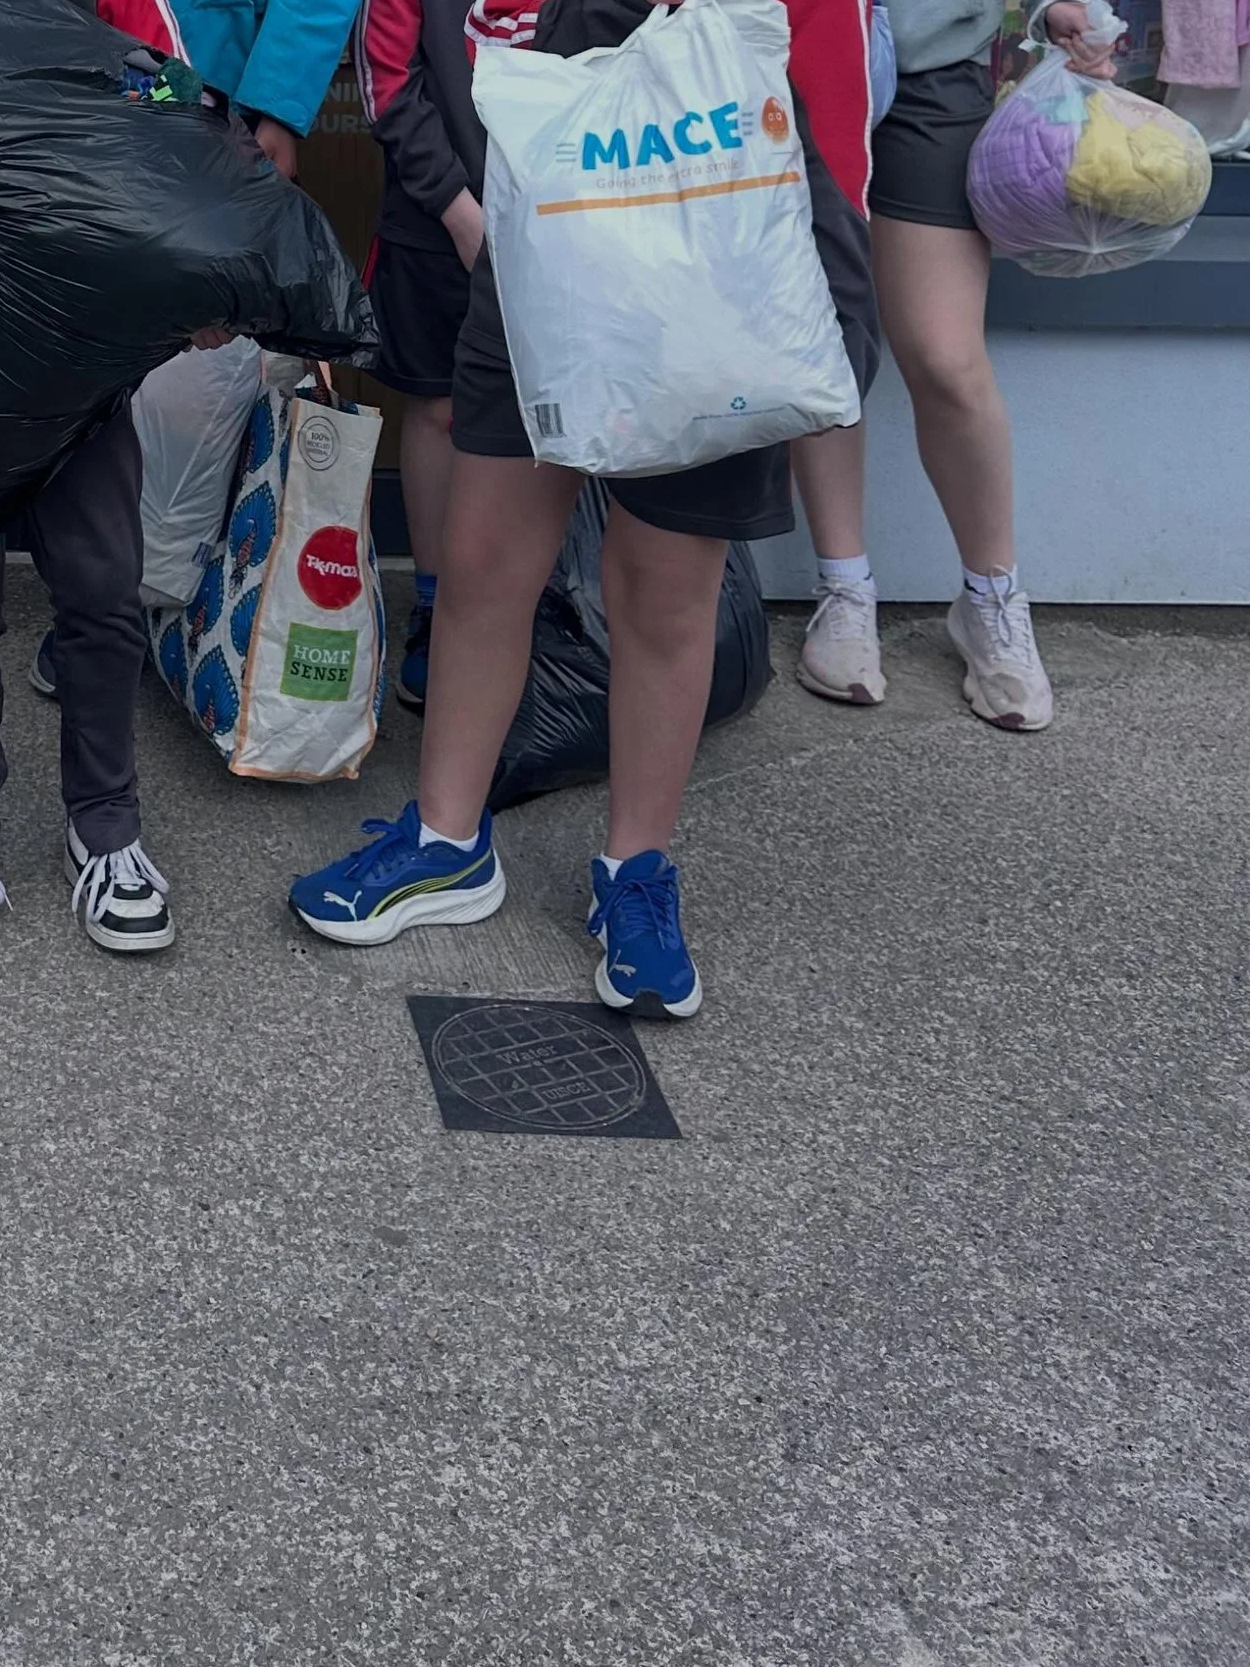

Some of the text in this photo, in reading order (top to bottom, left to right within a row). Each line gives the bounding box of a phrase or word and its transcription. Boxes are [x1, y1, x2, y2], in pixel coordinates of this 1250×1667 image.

[582, 101, 743, 171] MACE
[597, 177, 636, 191] Going
[641, 173, 664, 185] the
[293, 645, 350, 665] HOME
[291, 662, 348, 682] SENSE
[495, 1046, 558, 1065] Water
